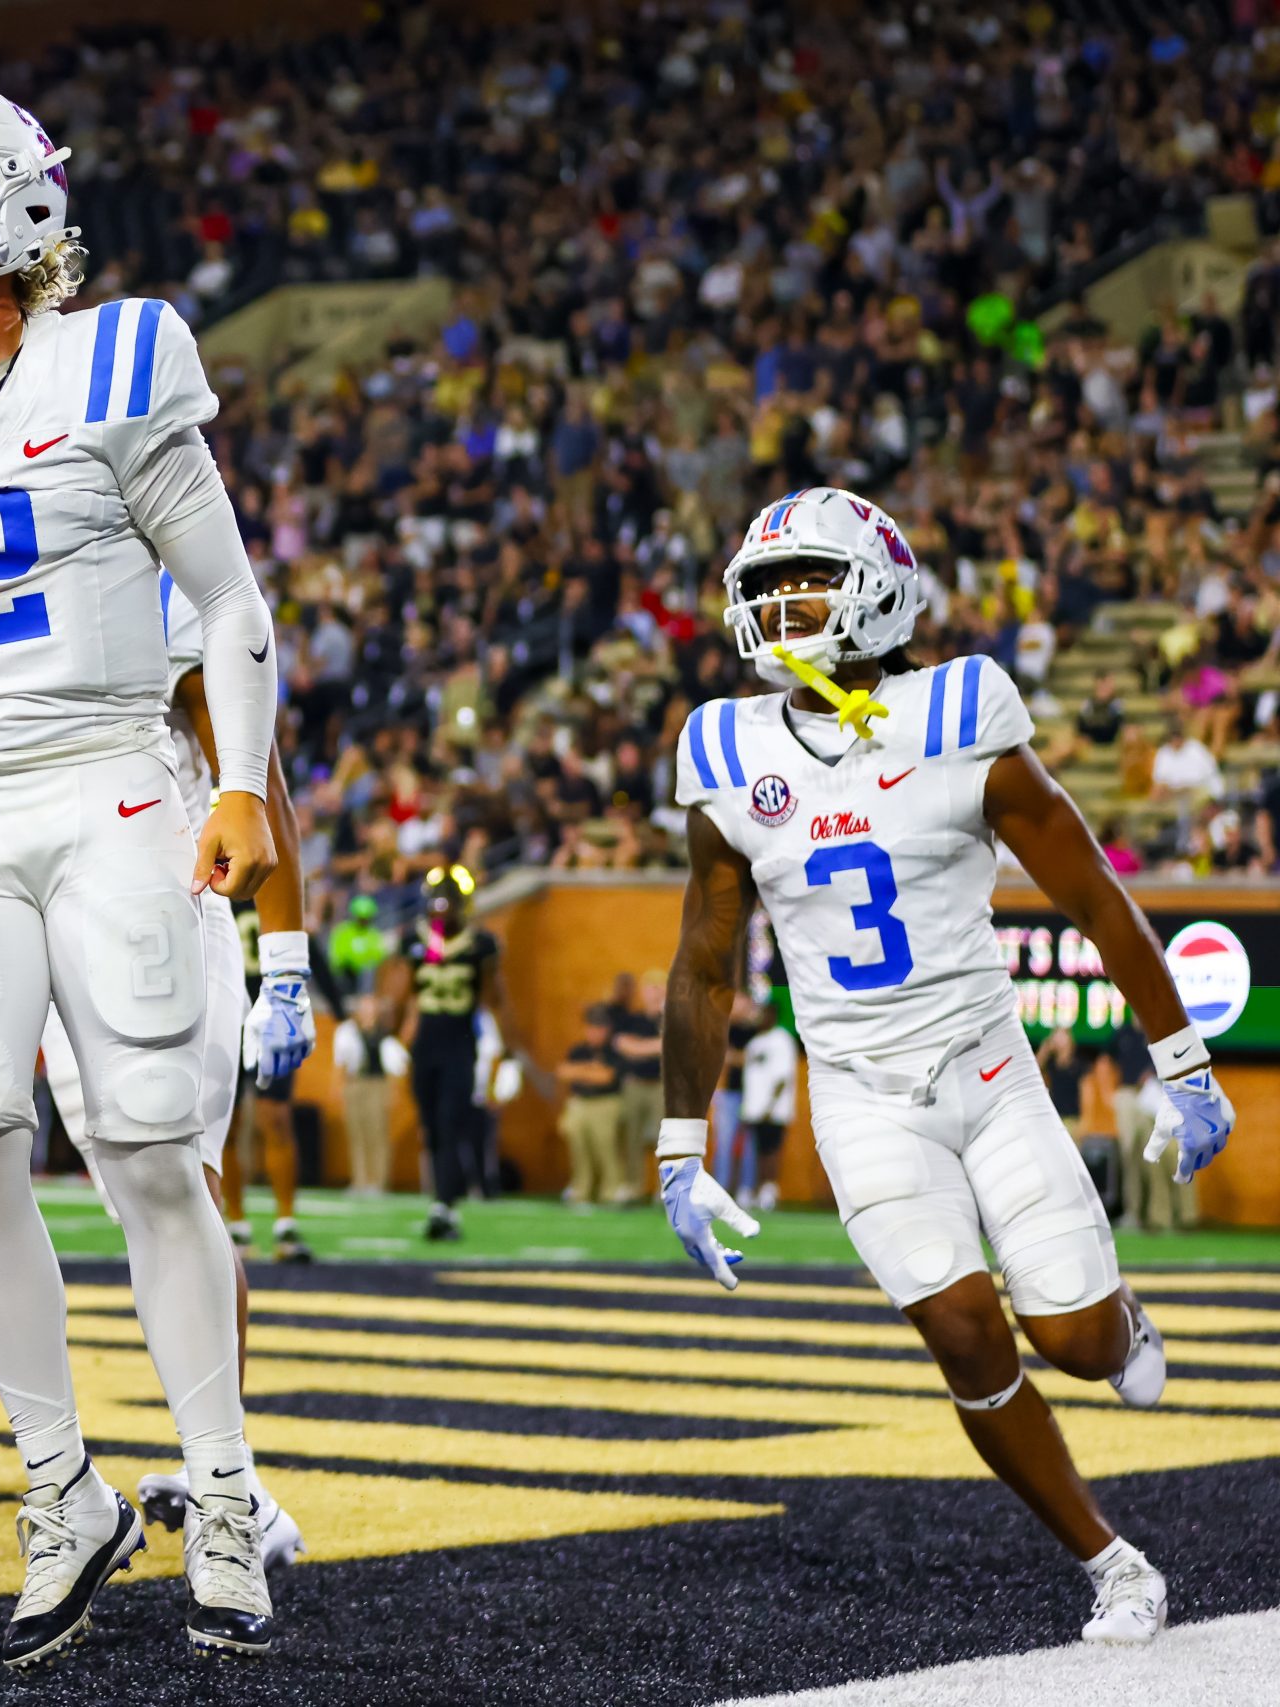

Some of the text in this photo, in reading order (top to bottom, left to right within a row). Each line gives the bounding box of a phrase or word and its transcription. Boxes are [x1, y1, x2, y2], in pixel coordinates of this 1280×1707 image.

[754, 775, 788, 814] SEC
[810, 811, 872, 842] Ole Miss
[804, 840, 914, 992] 3
